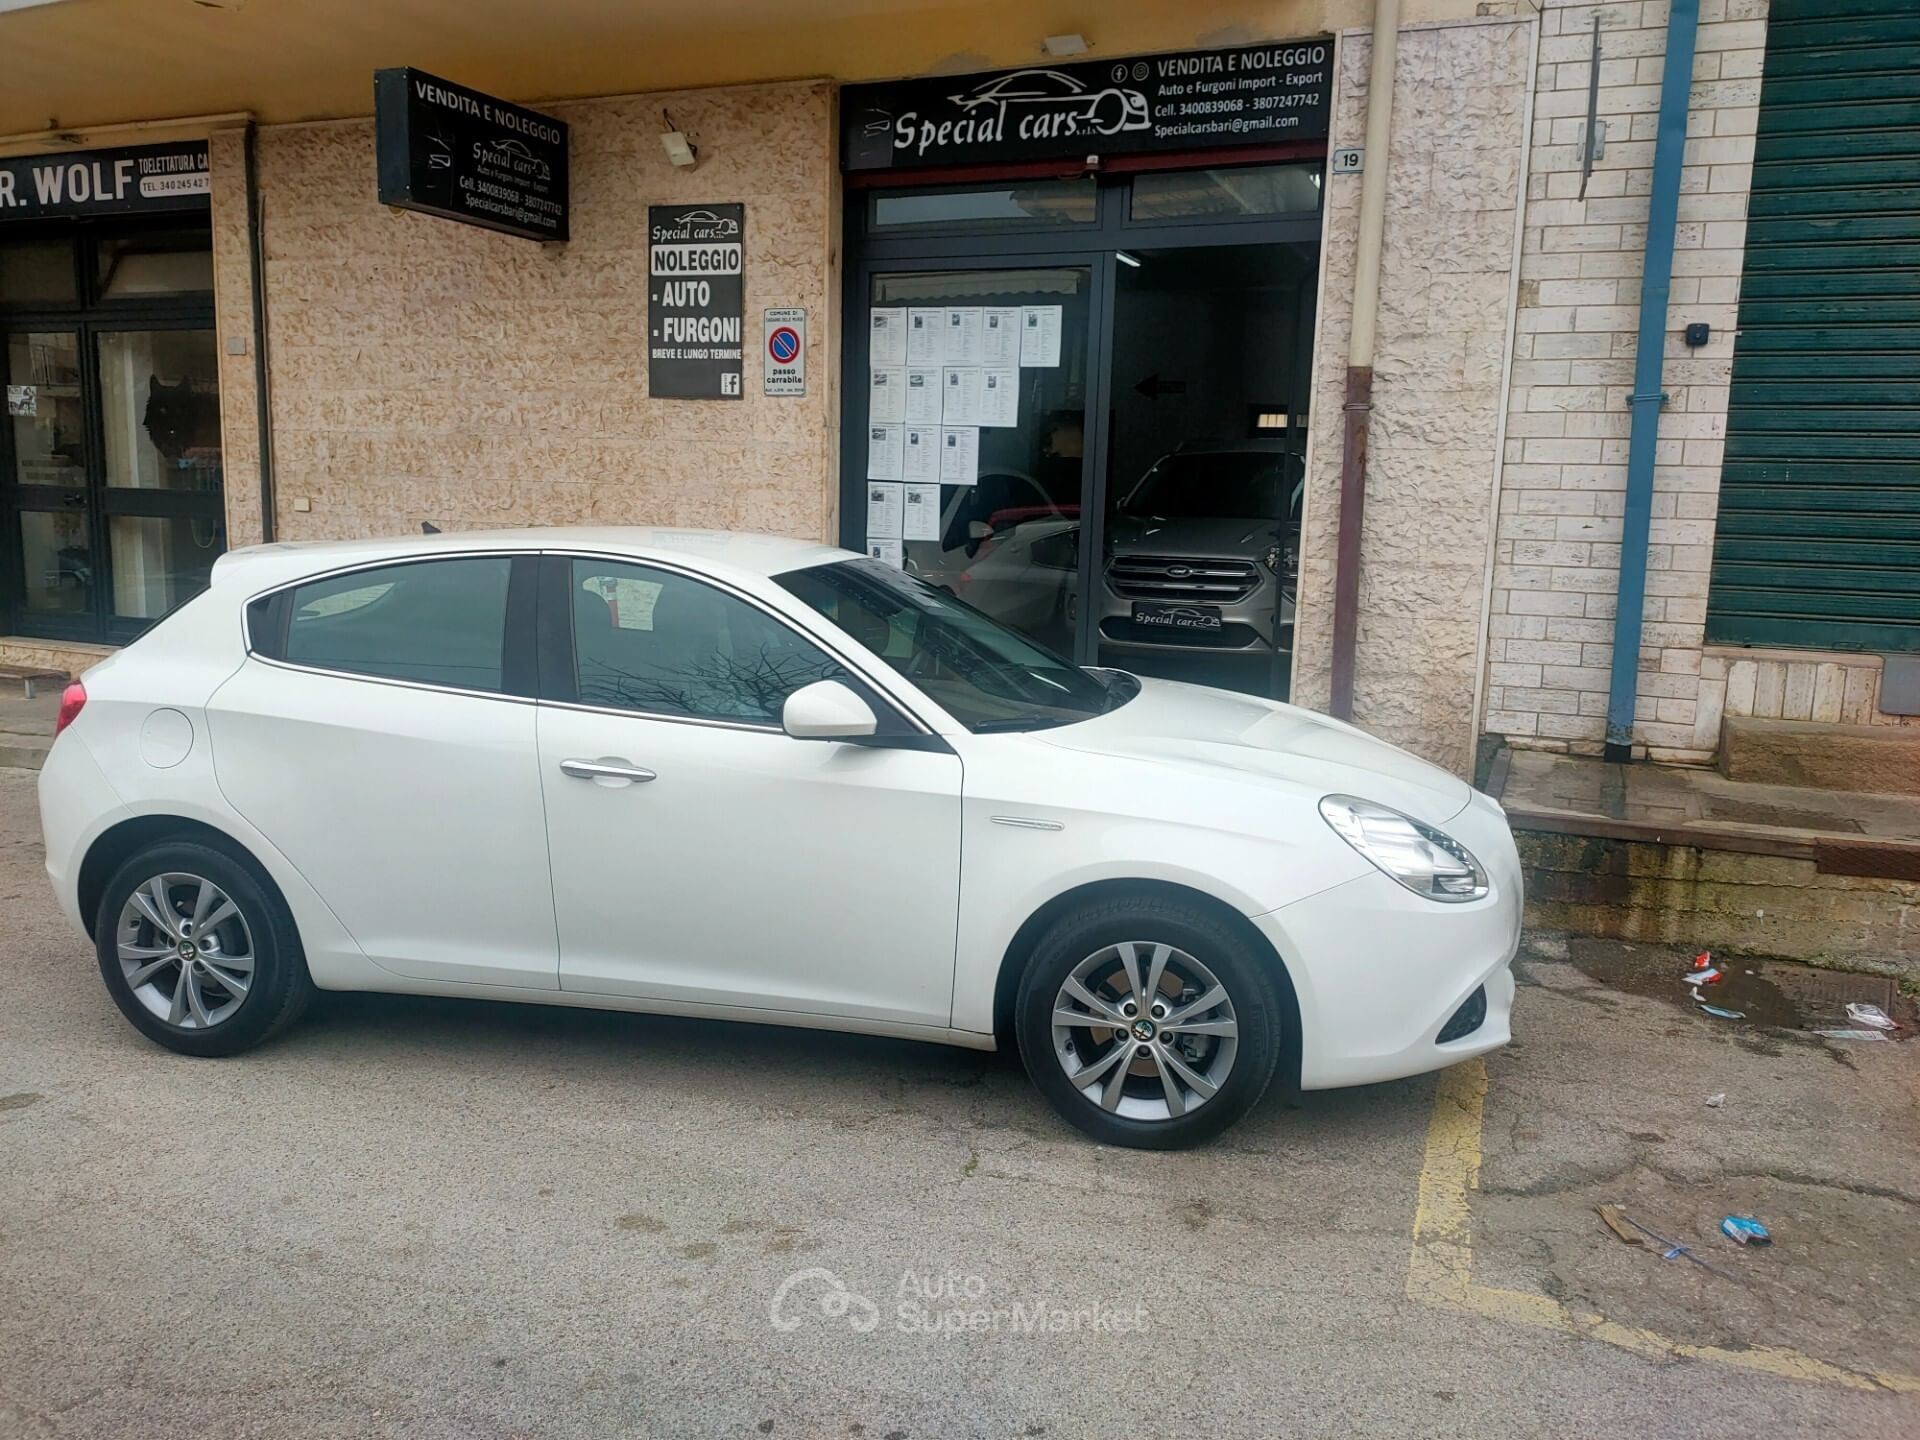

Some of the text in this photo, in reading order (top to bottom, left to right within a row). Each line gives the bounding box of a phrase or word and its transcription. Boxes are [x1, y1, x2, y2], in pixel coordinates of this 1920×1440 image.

[1157, 46, 1326, 78] VENDITA E NOLEGGIO
[1158, 83, 1185, 97] Auto
[1186, 84, 1193, 93] e
[1195, 78, 1237, 95] Furgoni
[1238, 75, 1277, 91] Import
[1285, 71, 1323, 89] Export
[415, 80, 560, 145] VENDITA E NOLEGGIO
[1154, 103, 1177, 118] Cell.
[1179, 98, 1244, 115] 3400839068
[1252, 93, 1320, 110] 3807247742
[894, 99, 1078, 157] Special cars
[1154, 115, 1299, 139] Specialcarsbari@gmail.com
[138, 154, 195, 175] TOELETTATURA
[1343, 153, 1359, 167] 19
[32, 160, 135, 205] WOLF
[652, 223, 691, 243] Special
[694, 228, 715, 239] cars
[654, 249, 739, 271] NOLEGGIO
[662, 281, 710, 307] AUTO
[663, 316, 740, 343] FURGONI
[652, 348, 742, 360] BREVE E LUNGO TERMINE
[766, 376, 803, 384] carrabile
[772, 368, 796, 376] passo
[1135, 612, 1174, 626] Special
